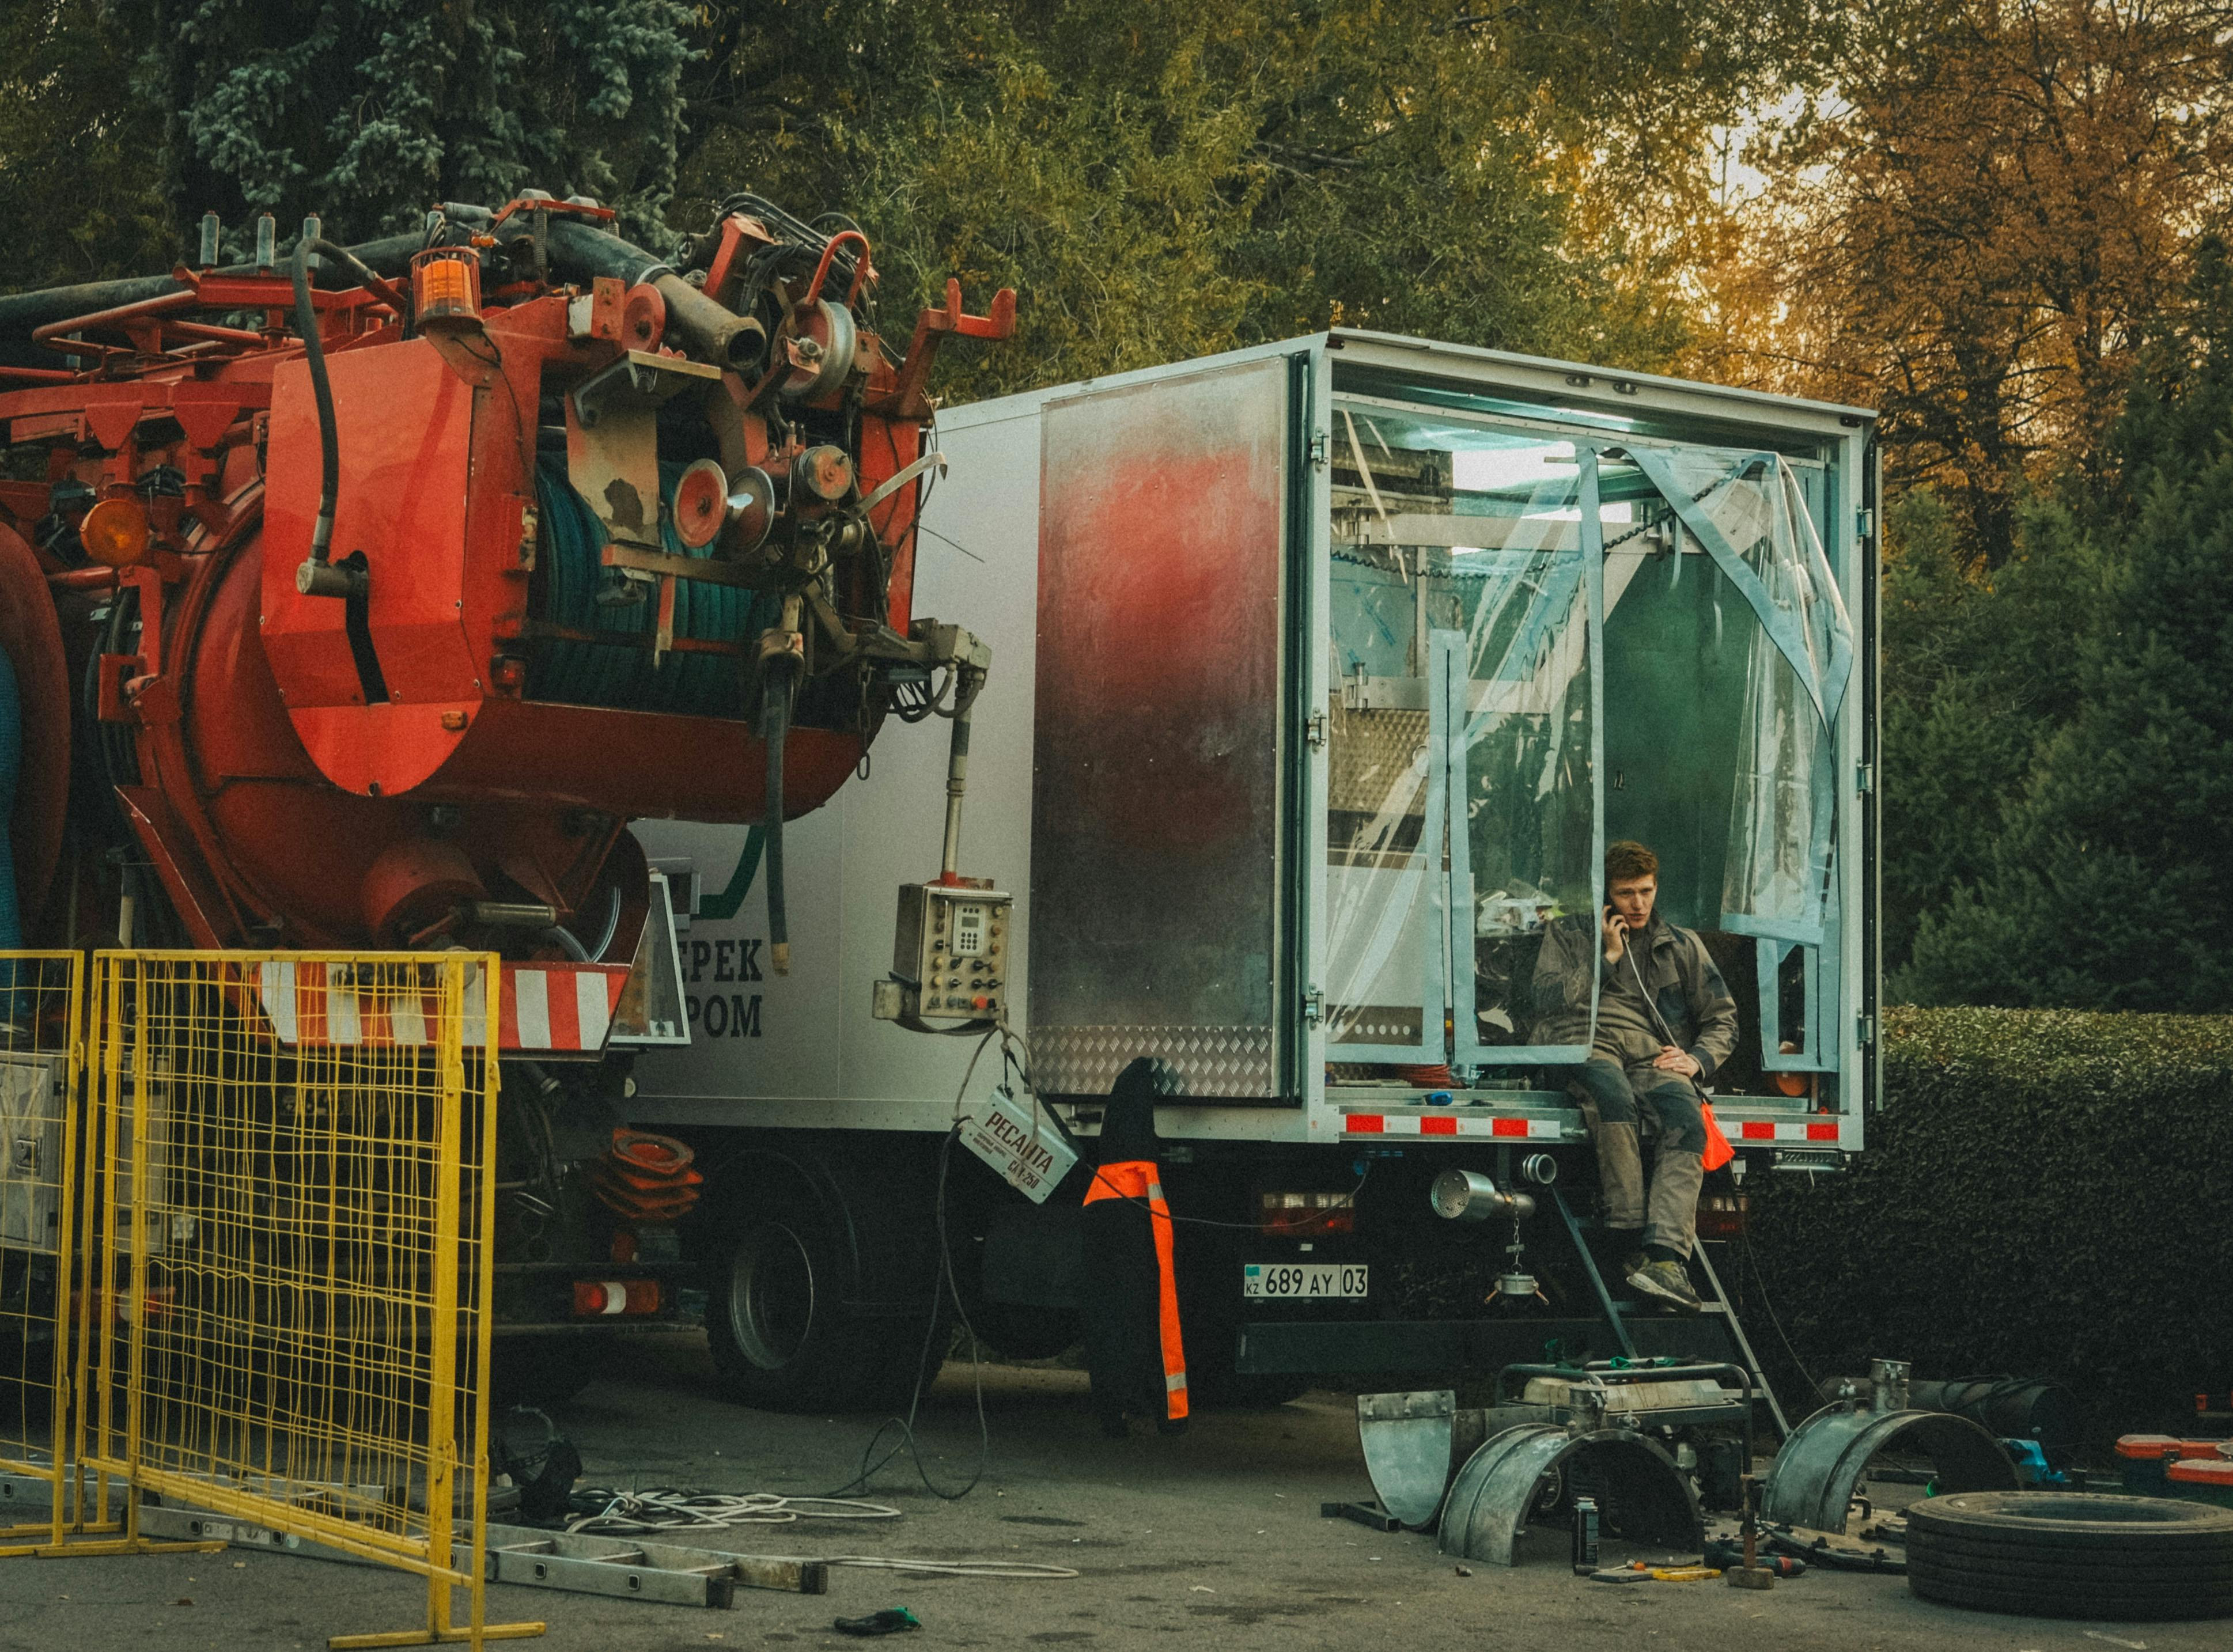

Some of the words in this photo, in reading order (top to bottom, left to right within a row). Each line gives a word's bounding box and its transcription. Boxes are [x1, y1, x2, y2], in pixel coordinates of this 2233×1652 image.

[1246, 1283, 1259, 1295] KZ
[1265, 1268, 1304, 1294] 689
[1309, 1274, 1333, 1295] AY
[1342, 1268, 1367, 1294] 03
